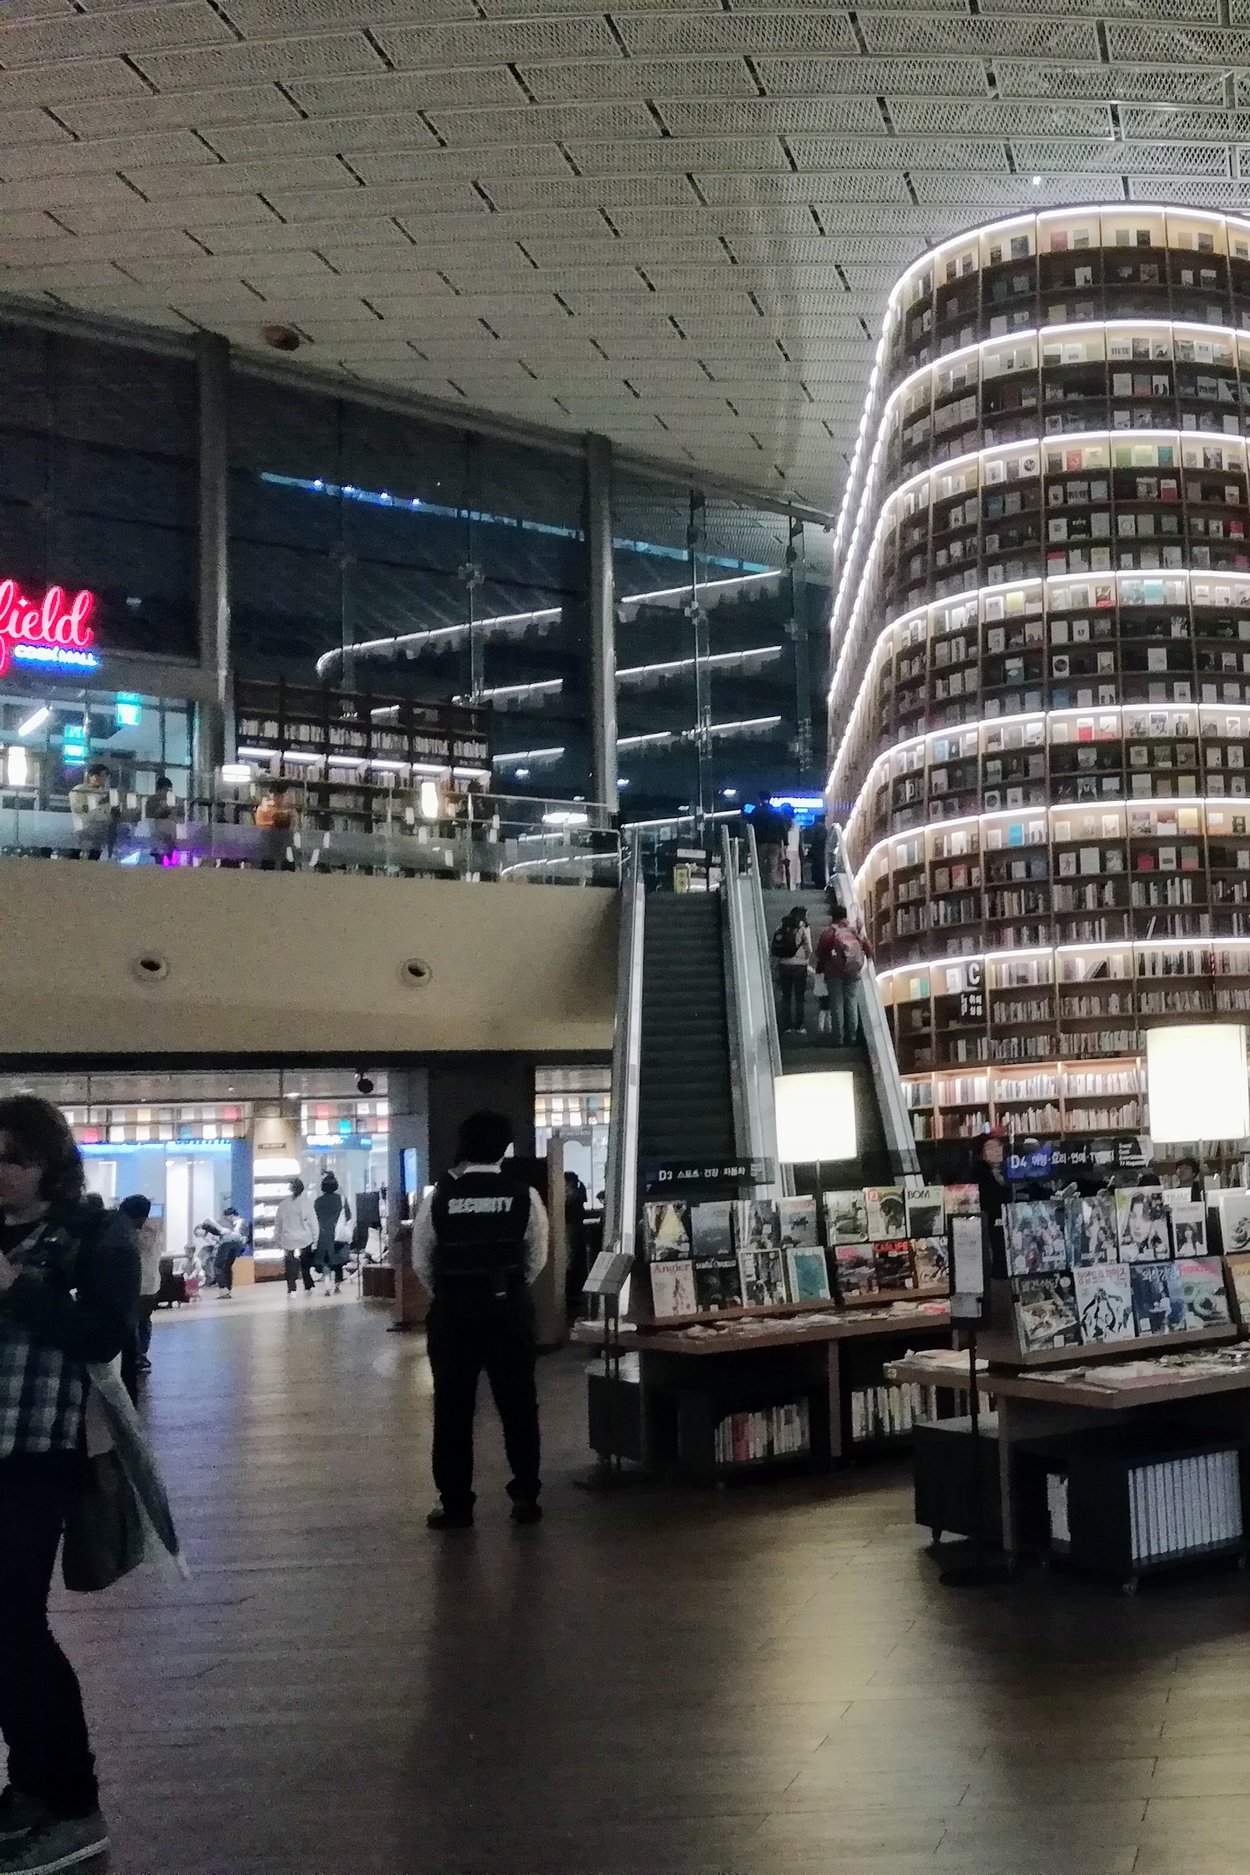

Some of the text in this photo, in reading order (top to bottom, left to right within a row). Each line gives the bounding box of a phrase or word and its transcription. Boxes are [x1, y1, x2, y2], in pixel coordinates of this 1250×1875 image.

[968, 962, 981, 985] C
[1010, 1154, 1028, 1169] D4
[658, 1169, 673, 1182] D3
